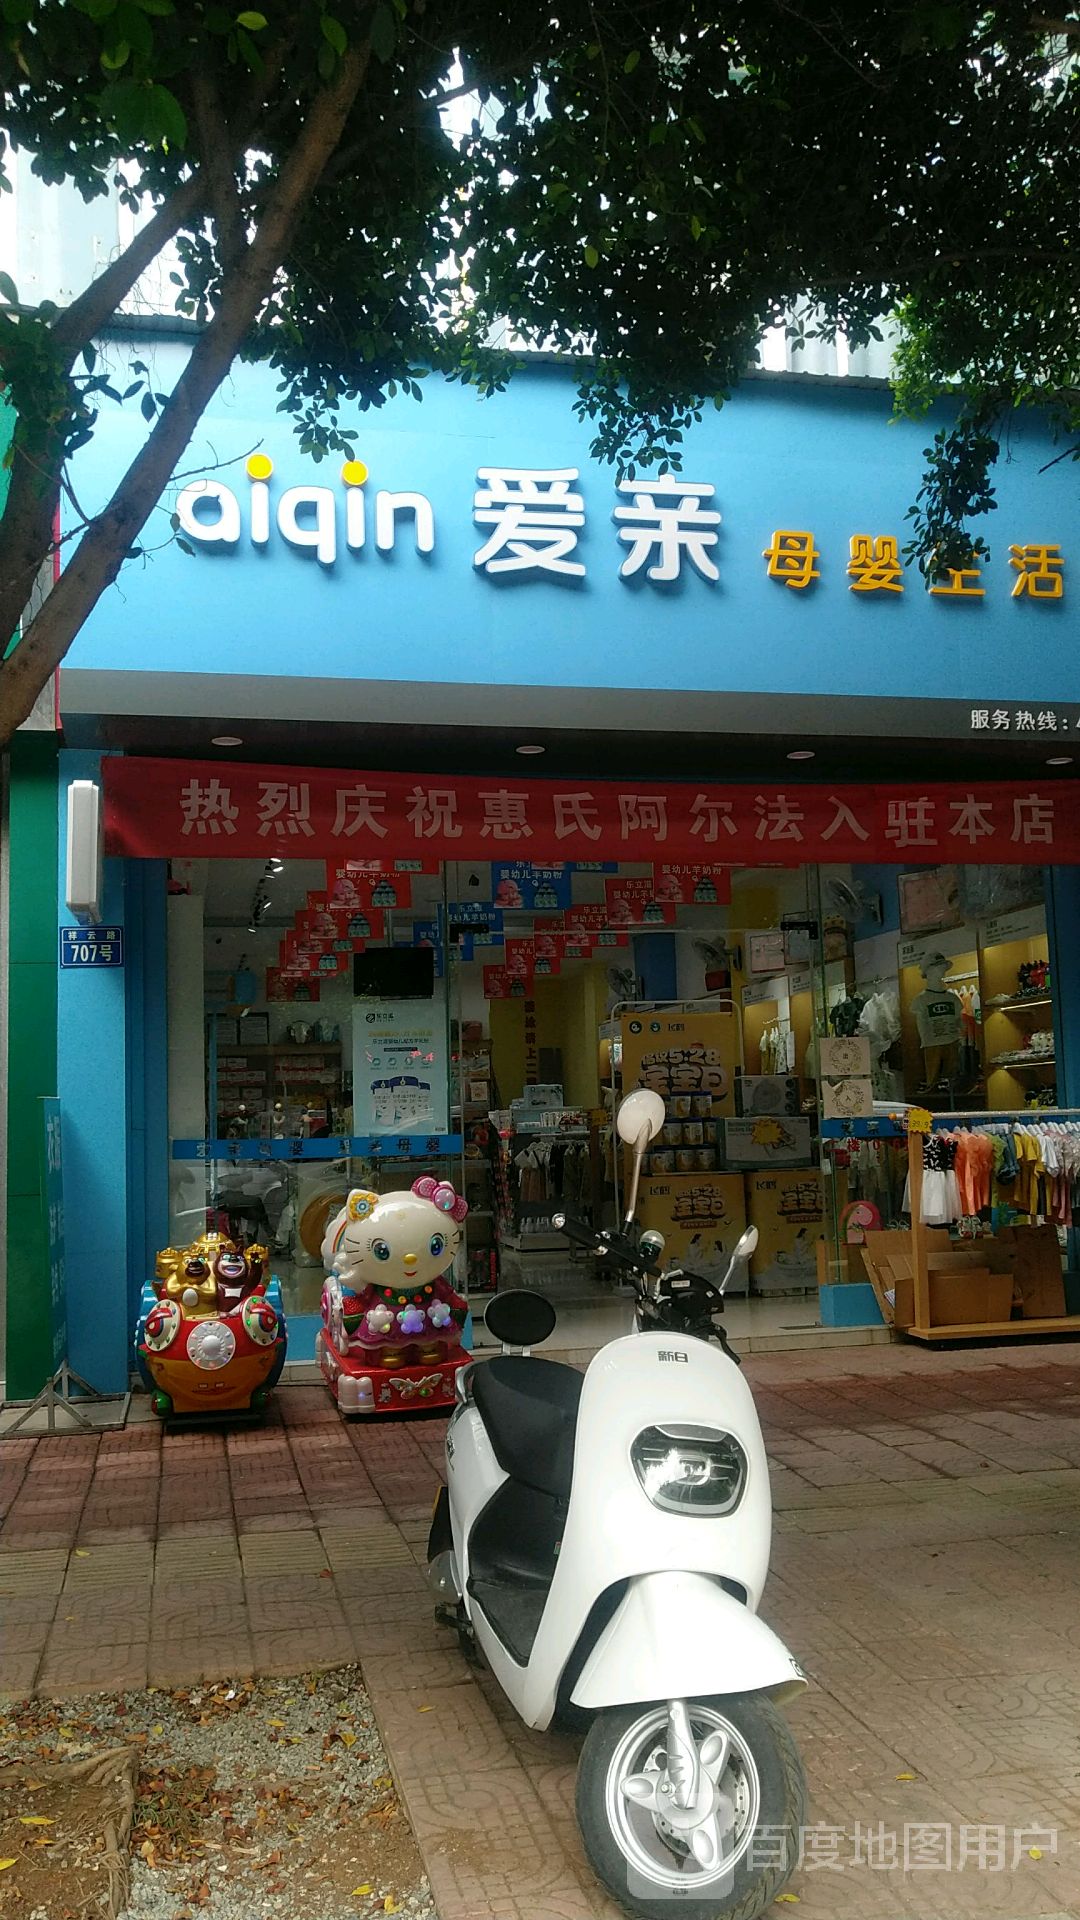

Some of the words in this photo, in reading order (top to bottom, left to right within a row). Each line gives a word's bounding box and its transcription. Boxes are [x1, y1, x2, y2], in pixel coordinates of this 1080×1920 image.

[176, 453, 436, 565] aiqin
[473, 467, 722, 582] 爱亲
[179, 777, 1057, 848] 热烈庆祝惠氏阿尔法入驻本店
[68, 931, 117, 940] 祥云路
[70, 944, 113, 962] 707号
[657, 1350, 689, 1363] 新日
